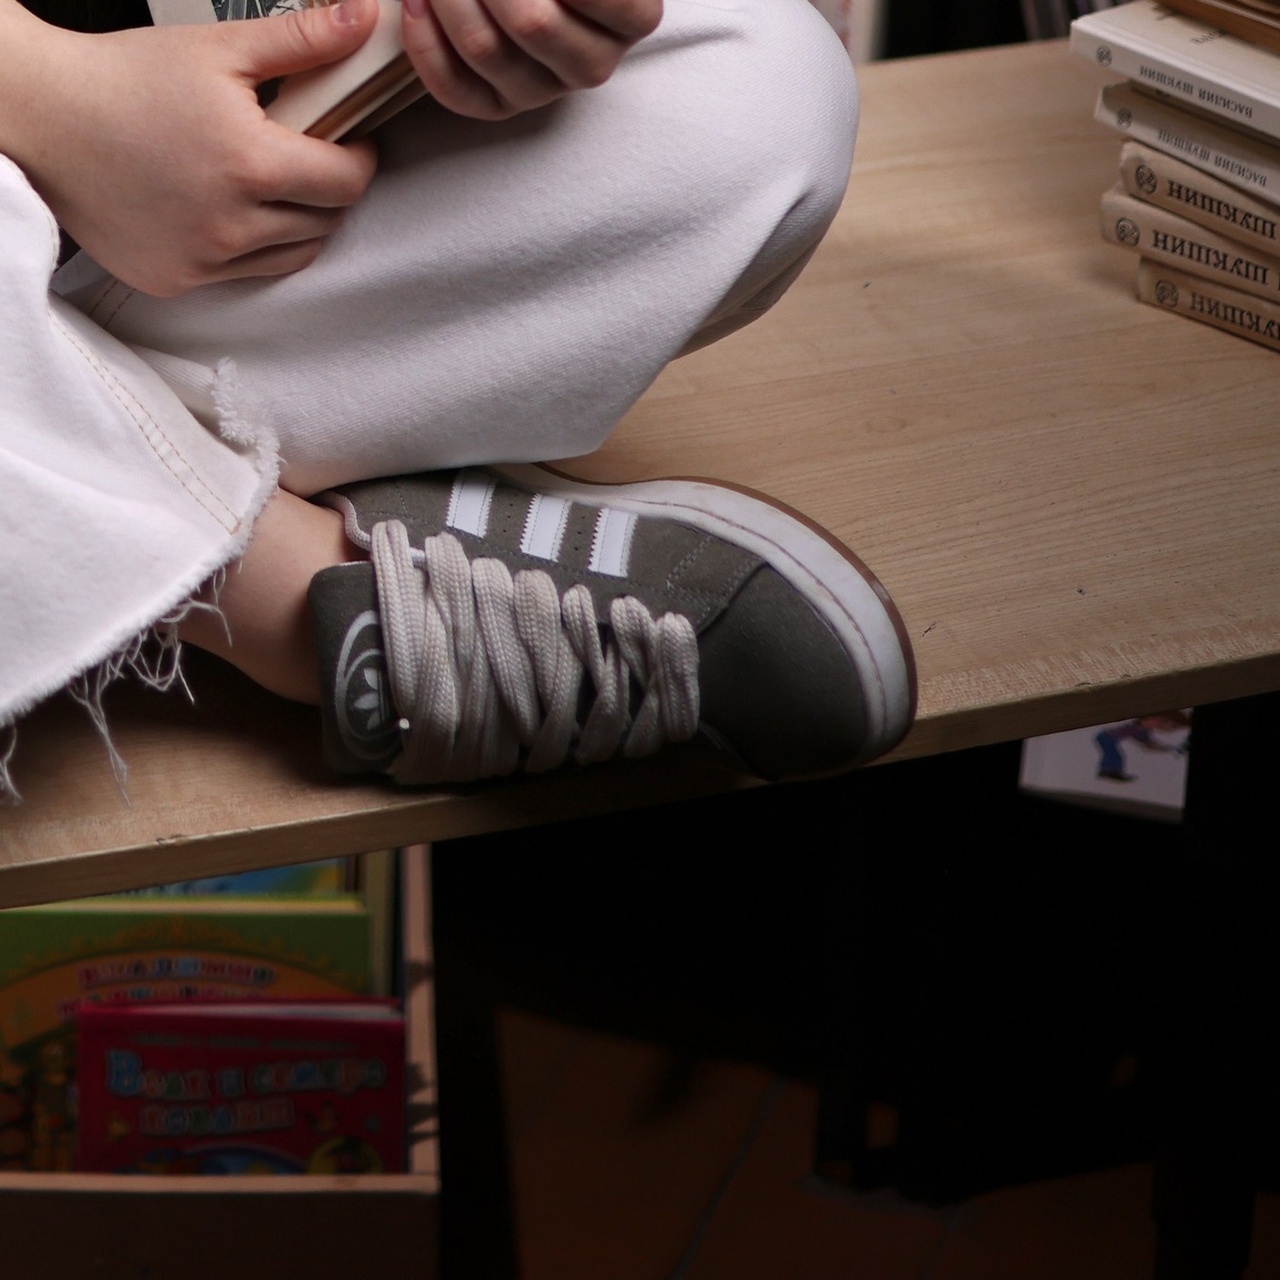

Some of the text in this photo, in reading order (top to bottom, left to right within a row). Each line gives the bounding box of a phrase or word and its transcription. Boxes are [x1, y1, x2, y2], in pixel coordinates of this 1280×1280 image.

[1138, 62, 1255, 120] ВАСИЛИЙ ШУКШИН
[1157, 126, 1268, 189] ВАСИЛИЙ ШУКШИН
[1167, 179, 1278, 241] ШУКШИН
[1151, 228, 1269, 287] ШУКШИН
[1189, 290, 1280, 344] УКШИН
